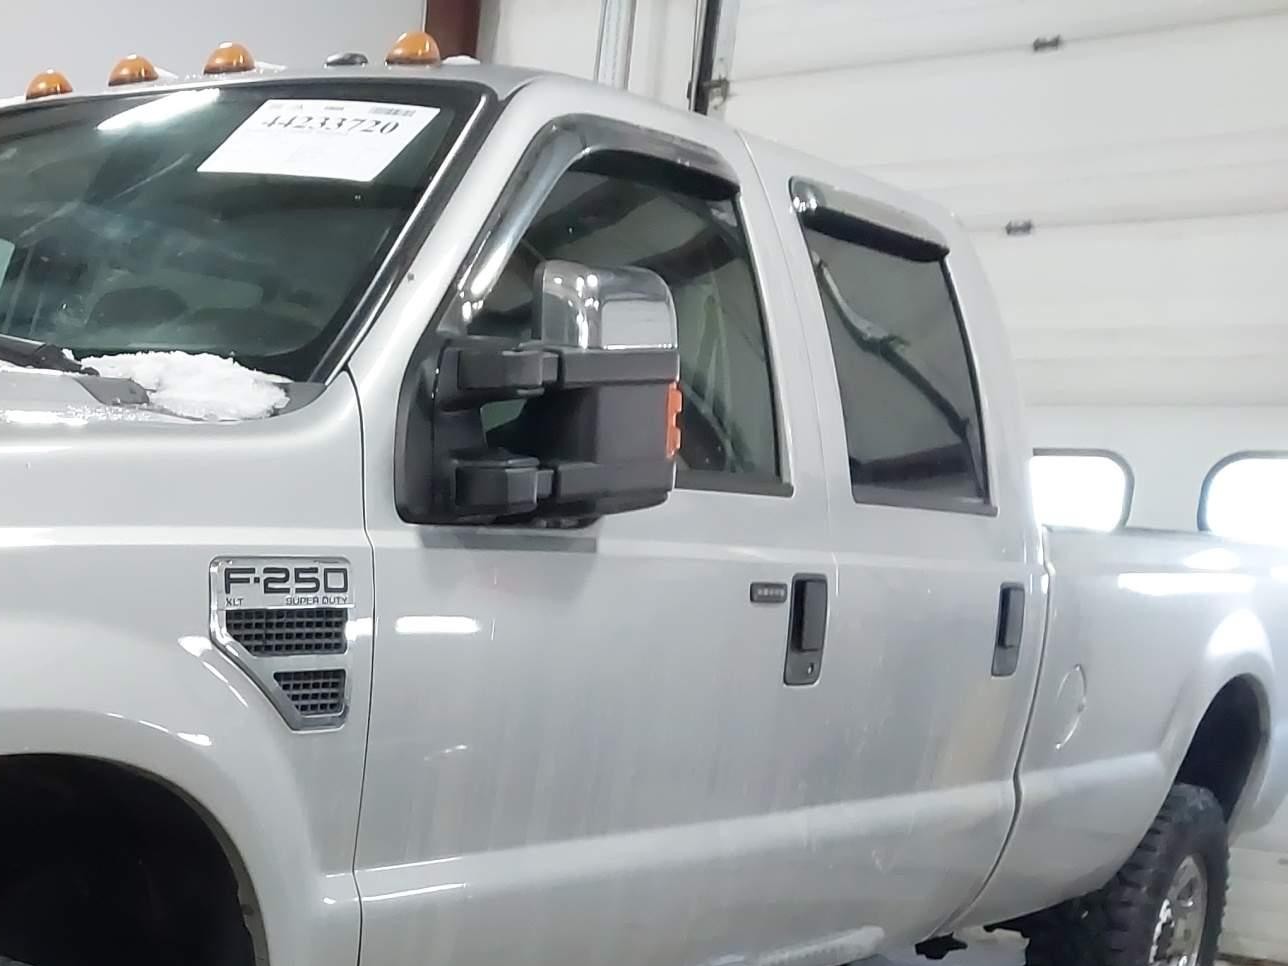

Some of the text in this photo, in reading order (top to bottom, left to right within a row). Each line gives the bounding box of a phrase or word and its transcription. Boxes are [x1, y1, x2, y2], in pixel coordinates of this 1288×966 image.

[261, 115, 400, 135] 44233720
[224, 567, 349, 594] F-250
[225, 596, 348, 607] XLT SUPER DUTY
